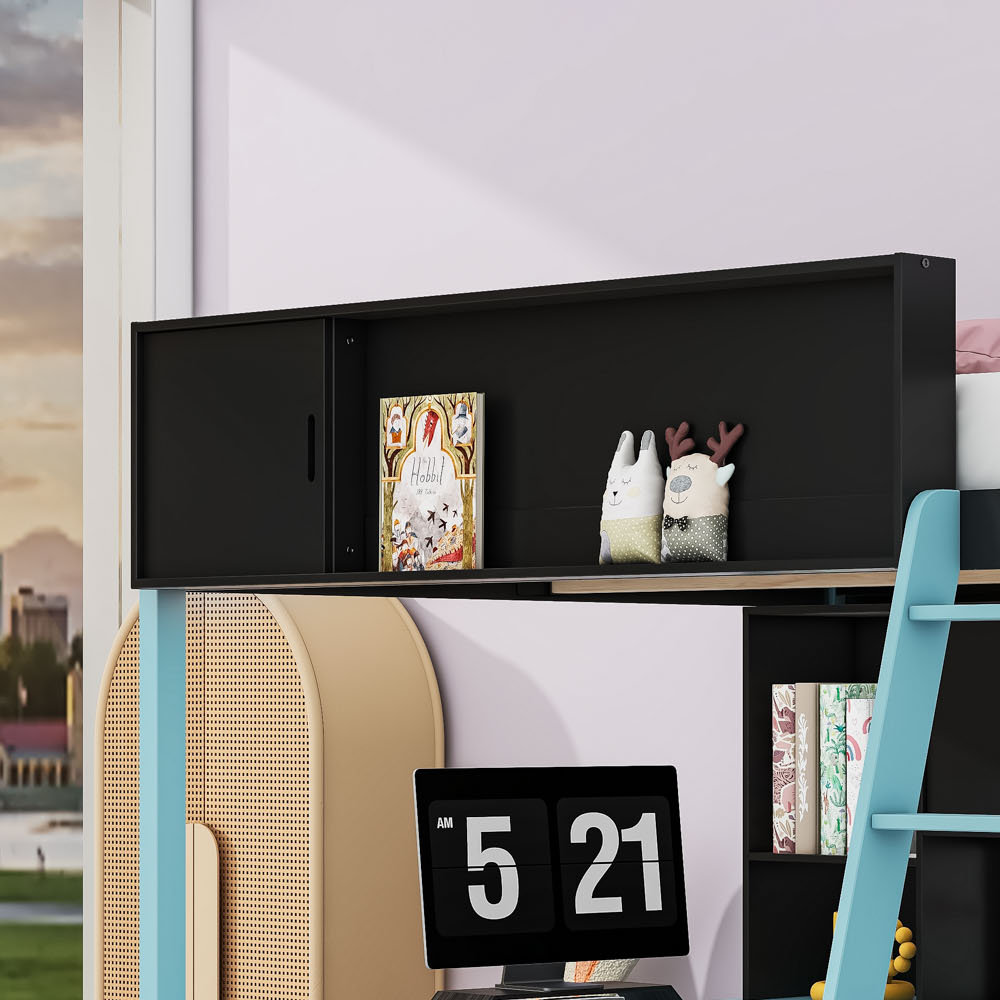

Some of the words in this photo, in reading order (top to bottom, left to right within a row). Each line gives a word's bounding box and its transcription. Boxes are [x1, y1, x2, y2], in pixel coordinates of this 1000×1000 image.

[436, 816, 453, 829] AM
[466, 816, 520, 920] 5
[570, 812, 663, 914] 21
